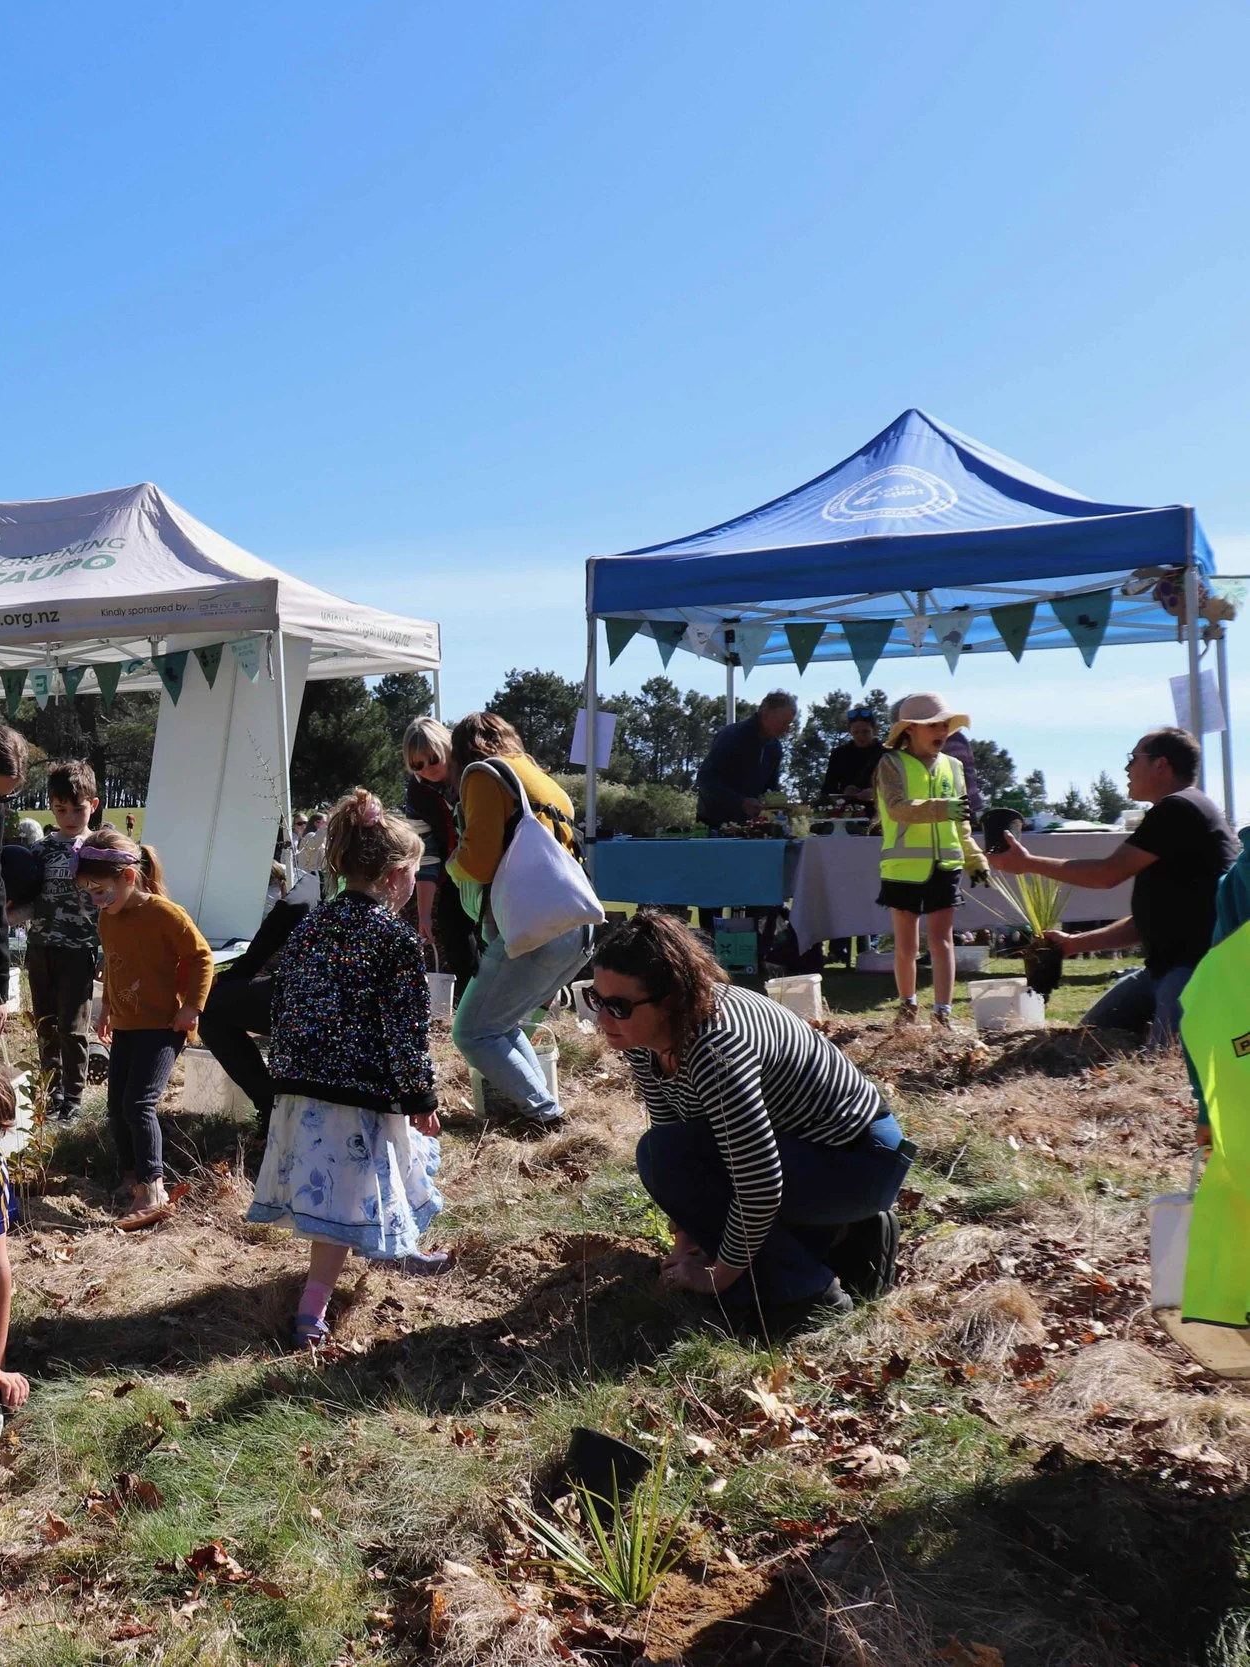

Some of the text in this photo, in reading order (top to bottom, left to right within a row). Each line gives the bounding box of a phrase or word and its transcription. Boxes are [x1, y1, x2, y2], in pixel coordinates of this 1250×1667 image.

[100, 608, 126, 617] Kindly
[128, 605, 173, 616] sponsored
[175, 603, 195, 614] by...
